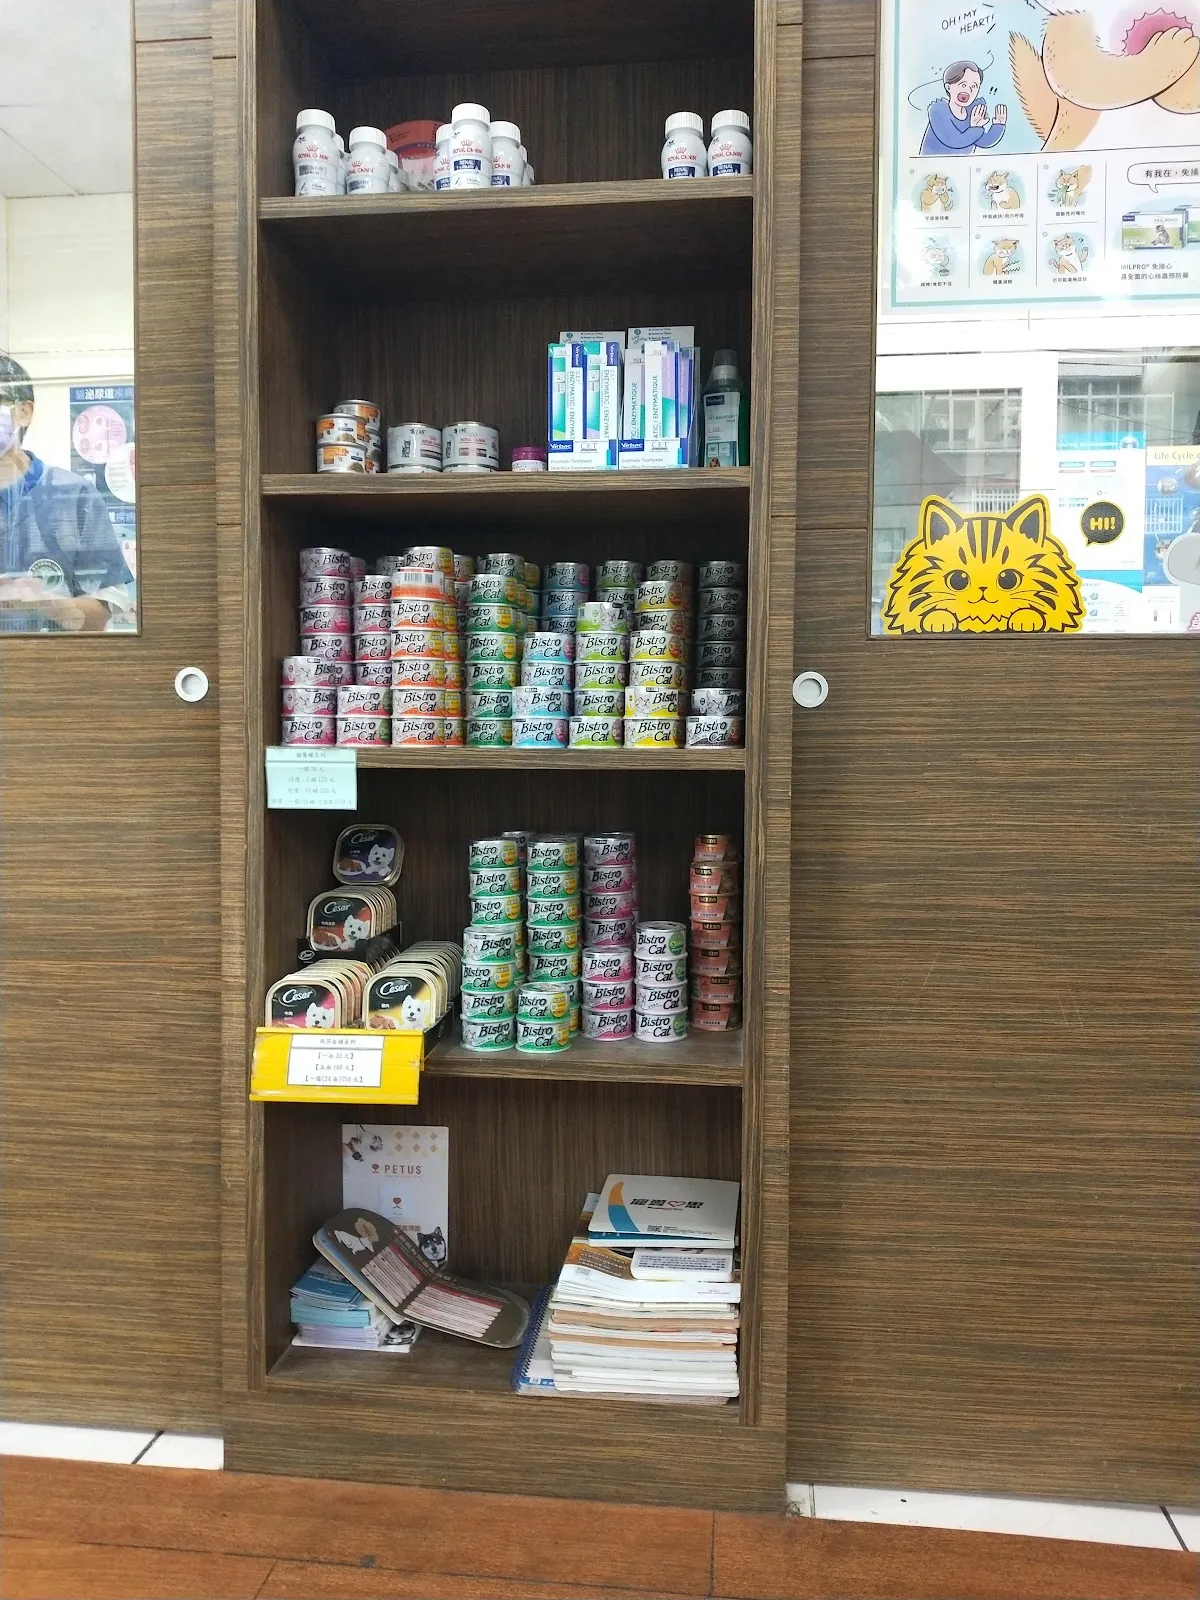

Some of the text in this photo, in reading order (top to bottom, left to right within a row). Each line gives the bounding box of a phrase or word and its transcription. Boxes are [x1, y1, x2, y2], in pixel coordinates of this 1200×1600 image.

[964, 8, 977, 20] MY
[960, 13, 994, 34] HEART!
[1172, 452, 1193, 460] Cycle
[1090, 517, 1115, 530] HI!
[548, 568, 575, 579] Bistro
[470, 579, 500, 592] Bistro
[559, 576, 575, 586] Cat
[315, 582, 345, 593] Bistro
[638, 586, 665, 599] Bistro
[330, 591, 346, 601] Cat
[483, 588, 501, 599] Cat
[649, 595, 666, 605] Cat
[397, 603, 429, 615] Bistro
[302, 610, 329, 622] Bistro
[411, 613, 430, 624] Cat
[313, 619, 331, 629] Cat
[310, 638, 342, 650] Bistro
[358, 638, 386, 650] Bistro
[394, 633, 424, 645] Bistro
[470, 637, 497, 650] Bistro
[530, 638, 560, 650] Bistro
[586, 638, 617, 648] Bistro
[636, 637, 665, 648] Bistro
[324, 648, 342, 658] Cat
[370, 647, 387, 658] Cat
[406, 643, 425, 653] Cat
[480, 647, 498, 657] Cat
[543, 648, 560, 657] Cat
[601, 646, 617, 656] Cat
[648, 646, 666, 656] Cat
[397, 662, 429, 674] Bistro
[533, 666, 564, 678] Bistro
[584, 666, 615, 677] Bistro
[411, 672, 430, 682] Cat
[548, 676, 565, 686] Cat
[598, 675, 615, 684] Cat
[347, 692, 380, 703] Bistro
[478, 694, 509, 706] Bistro
[362, 700, 381, 711] Cat
[493, 704, 510, 715] Cat
[290, 721, 322, 733] Bistro
[402, 722, 435, 732] Bistro
[469, 722, 496, 734] Bistro
[521, 722, 552, 734] Bistro
[577, 722, 609, 734] Bistro
[638, 722, 670, 733] Bistro
[694, 721, 727, 734] Bistro
[304, 730, 324, 740] Cat
[418, 731, 435, 741] Cat
[479, 732, 497, 741] Cat
[535, 732, 553, 741] Cat
[591, 732, 609, 741] Cat
[654, 732, 671, 742] Cat
[709, 732, 728, 742] Cat
[351, 833, 376, 844] Cesar
[471, 846, 496, 857] Bistro
[481, 856, 498, 865] Cat
[531, 876, 560, 887] Bistro
[592, 870, 621, 882] Bistro
[605, 878, 622, 889] Cat
[543, 886, 560, 895] Cat
[324, 902, 351, 914] Cesar
[474, 901, 501, 913] Bistro
[533, 903, 564, 914] Bistro
[485, 912, 502, 920] Cat
[547, 913, 565, 922] Cat
[532, 929, 561, 941] Bistro
[545, 940, 562, 950] Cat
[590, 959, 620, 969] Bistro
[642, 962, 672, 972] Bistro
[464, 967, 490, 977] Bistro
[604, 968, 621, 978] Cat
[656, 972, 674, 982] Cat
[473, 977, 491, 988] Cat
[380, 982, 410, 995] Cesar
[595, 987, 625, 999] Bistro
[283, 989, 312, 1003] Cesar
[520, 996, 546, 1006] Bistro
[610, 996, 626, 1006] Cat
[648, 990, 679, 1001] Bistro
[472, 996, 504, 1008] Bistro
[663, 1000, 680, 1009] Cat
[488, 1005, 504, 1016] Cat
[529, 1007, 547, 1016] Cat
[598, 1014, 627, 1028] Bistro
[522, 1026, 553, 1037] Bistro
[613, 1024, 628, 1034] Cat
[535, 1036, 554, 1047] Cat
[384, 1164, 421, 1174] PETUS
